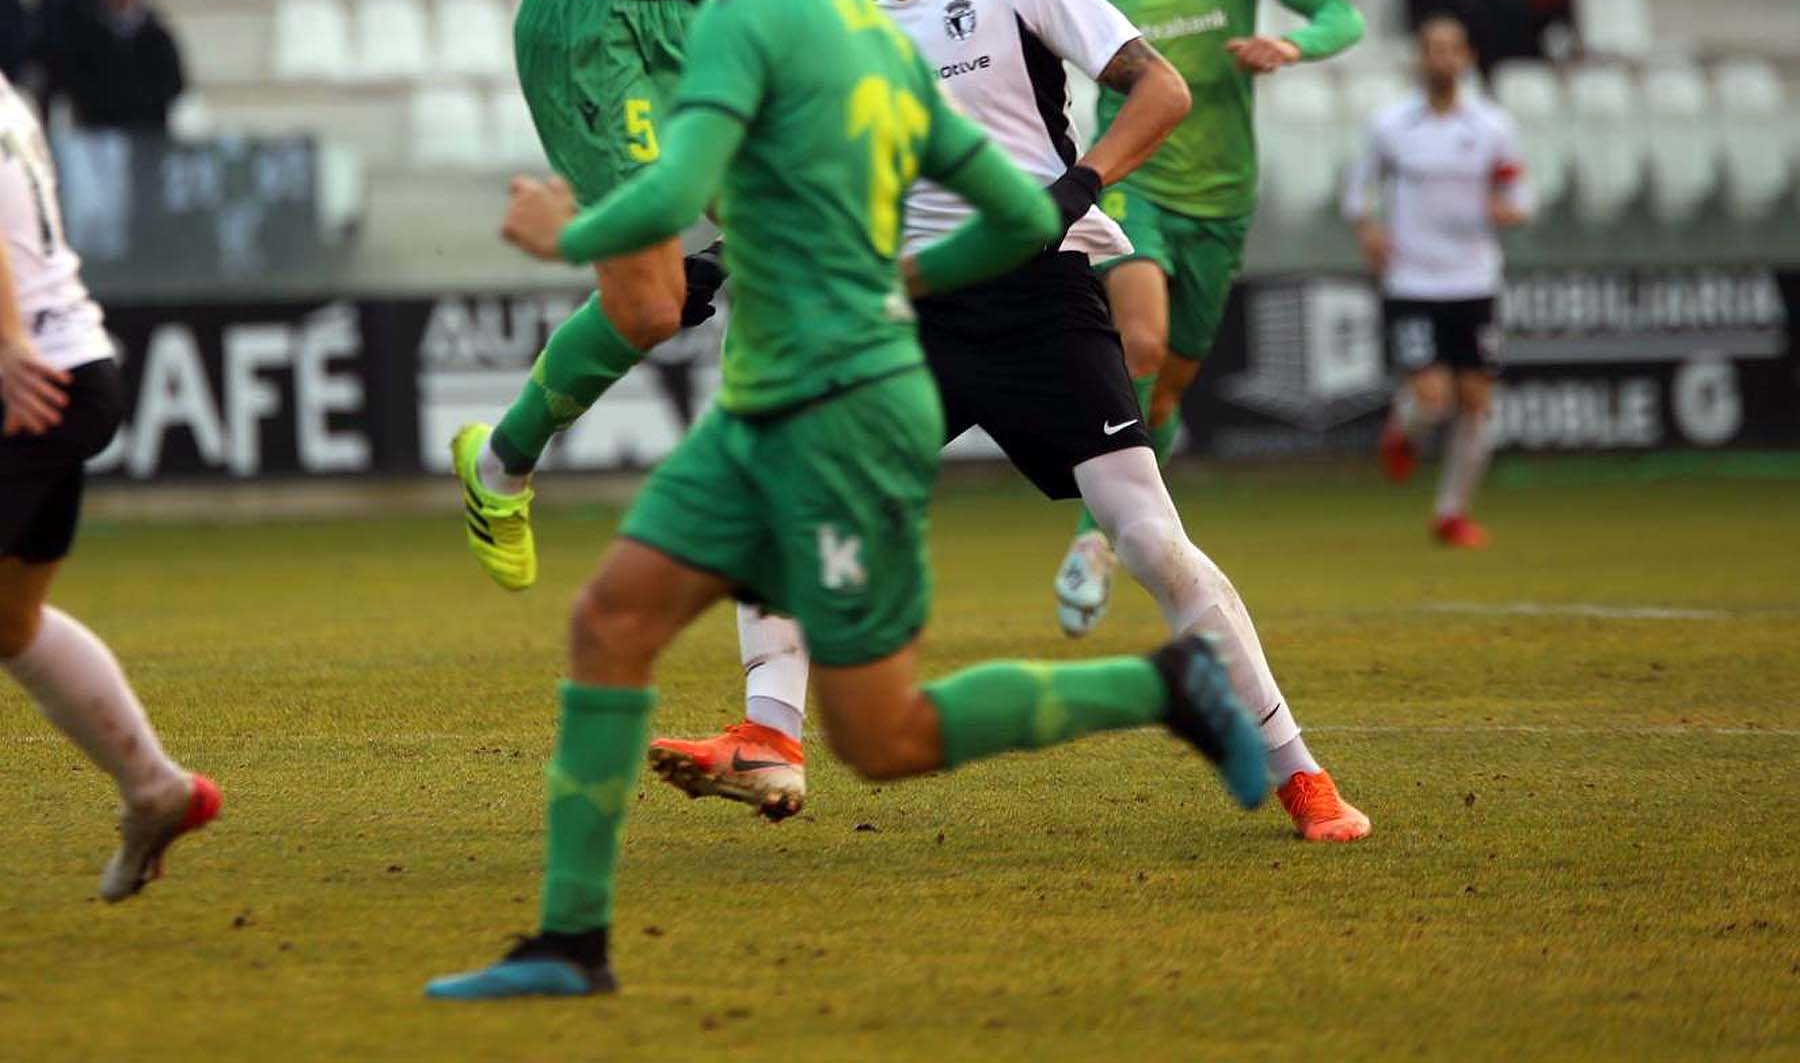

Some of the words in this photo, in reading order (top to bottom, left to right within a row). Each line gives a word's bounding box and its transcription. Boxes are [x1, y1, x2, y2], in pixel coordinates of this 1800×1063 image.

[936, 55, 991, 79] otive
[625, 99, 660, 164] 5
[1498, 272, 1786, 328] MOBILIARIA
